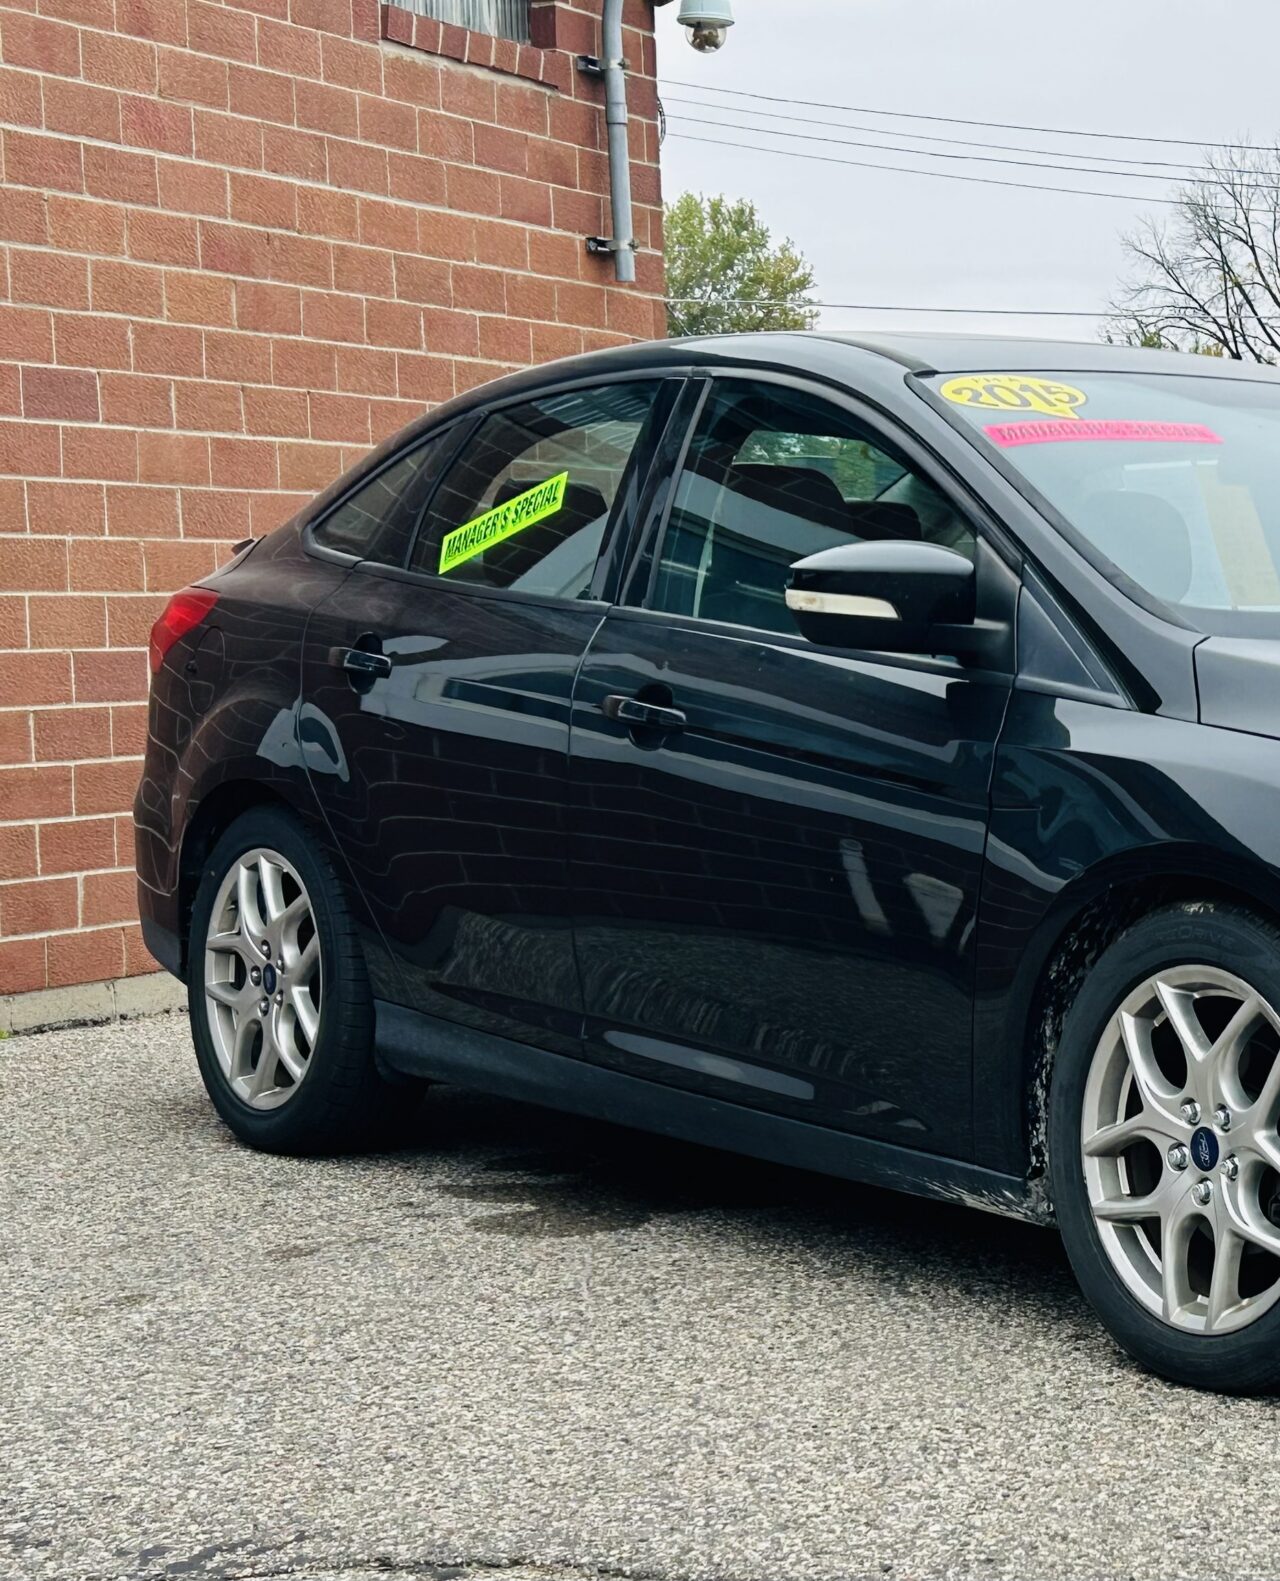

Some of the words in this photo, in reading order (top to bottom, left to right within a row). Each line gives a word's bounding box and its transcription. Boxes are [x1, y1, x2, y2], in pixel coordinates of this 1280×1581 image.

[951, 383, 1079, 408] 2015
[445, 506, 512, 561] MANAGER'S
[512, 479, 561, 523] SPECIAL
